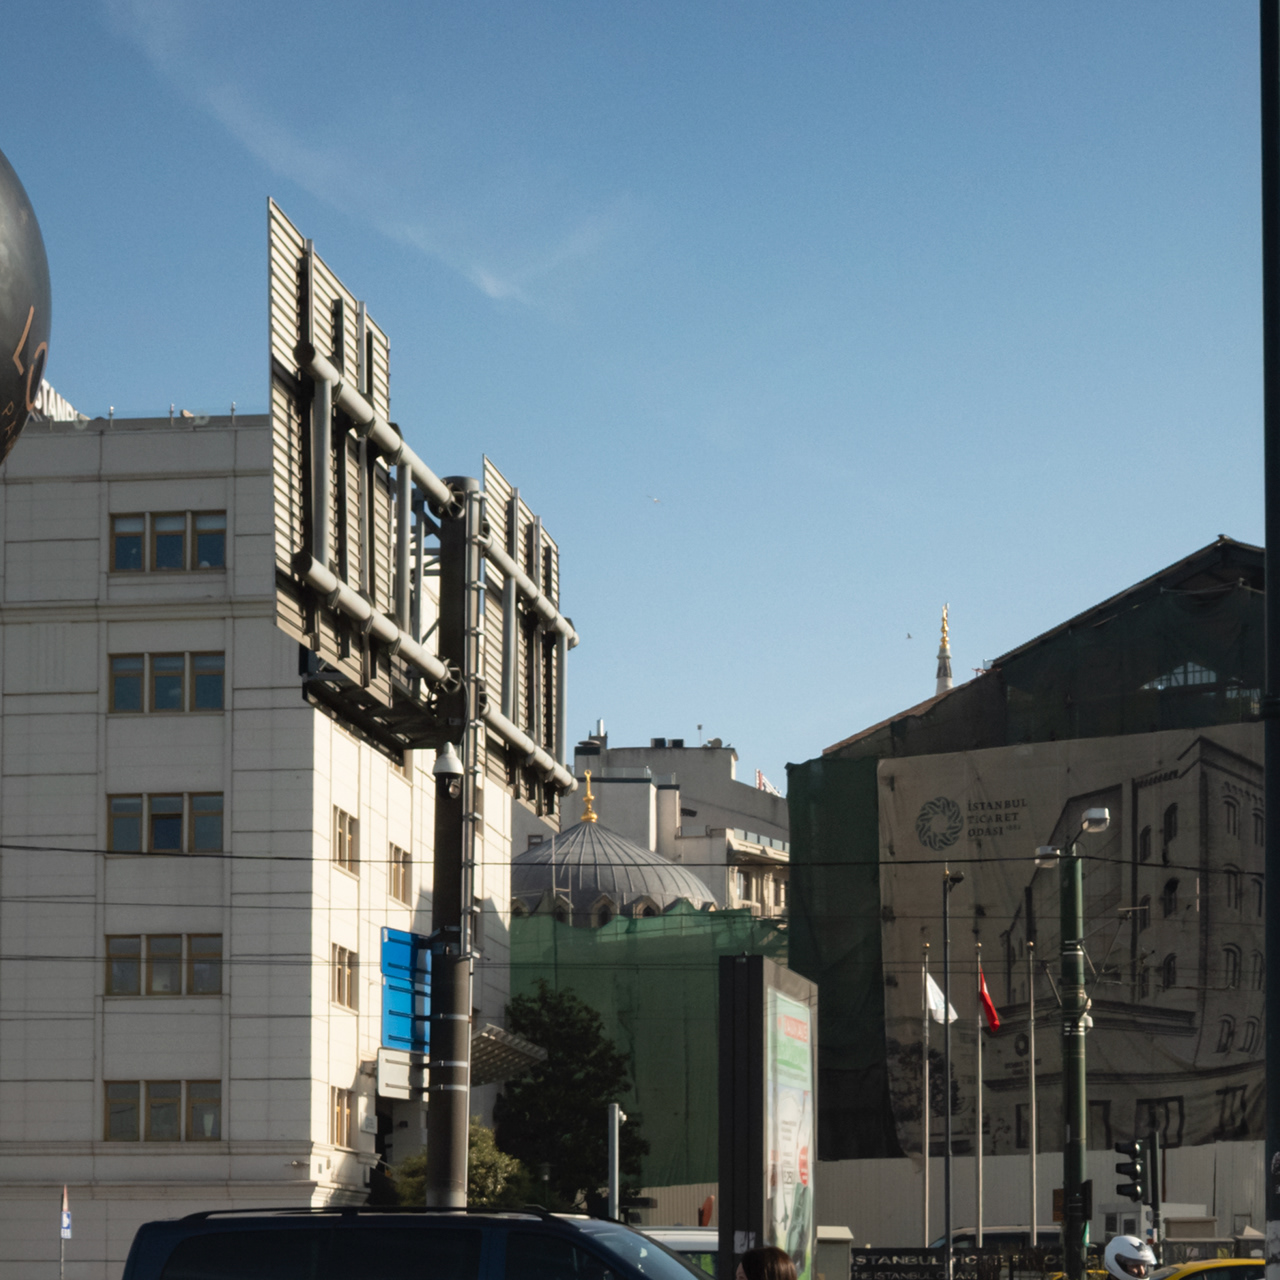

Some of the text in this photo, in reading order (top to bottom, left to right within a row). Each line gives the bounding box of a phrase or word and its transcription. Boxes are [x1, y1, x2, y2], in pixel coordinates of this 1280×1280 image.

[967, 798, 1028, 811] İSTANBUL
[967, 812, 1019, 824] TİCARET
[967, 827, 1004, 838] ODASI
